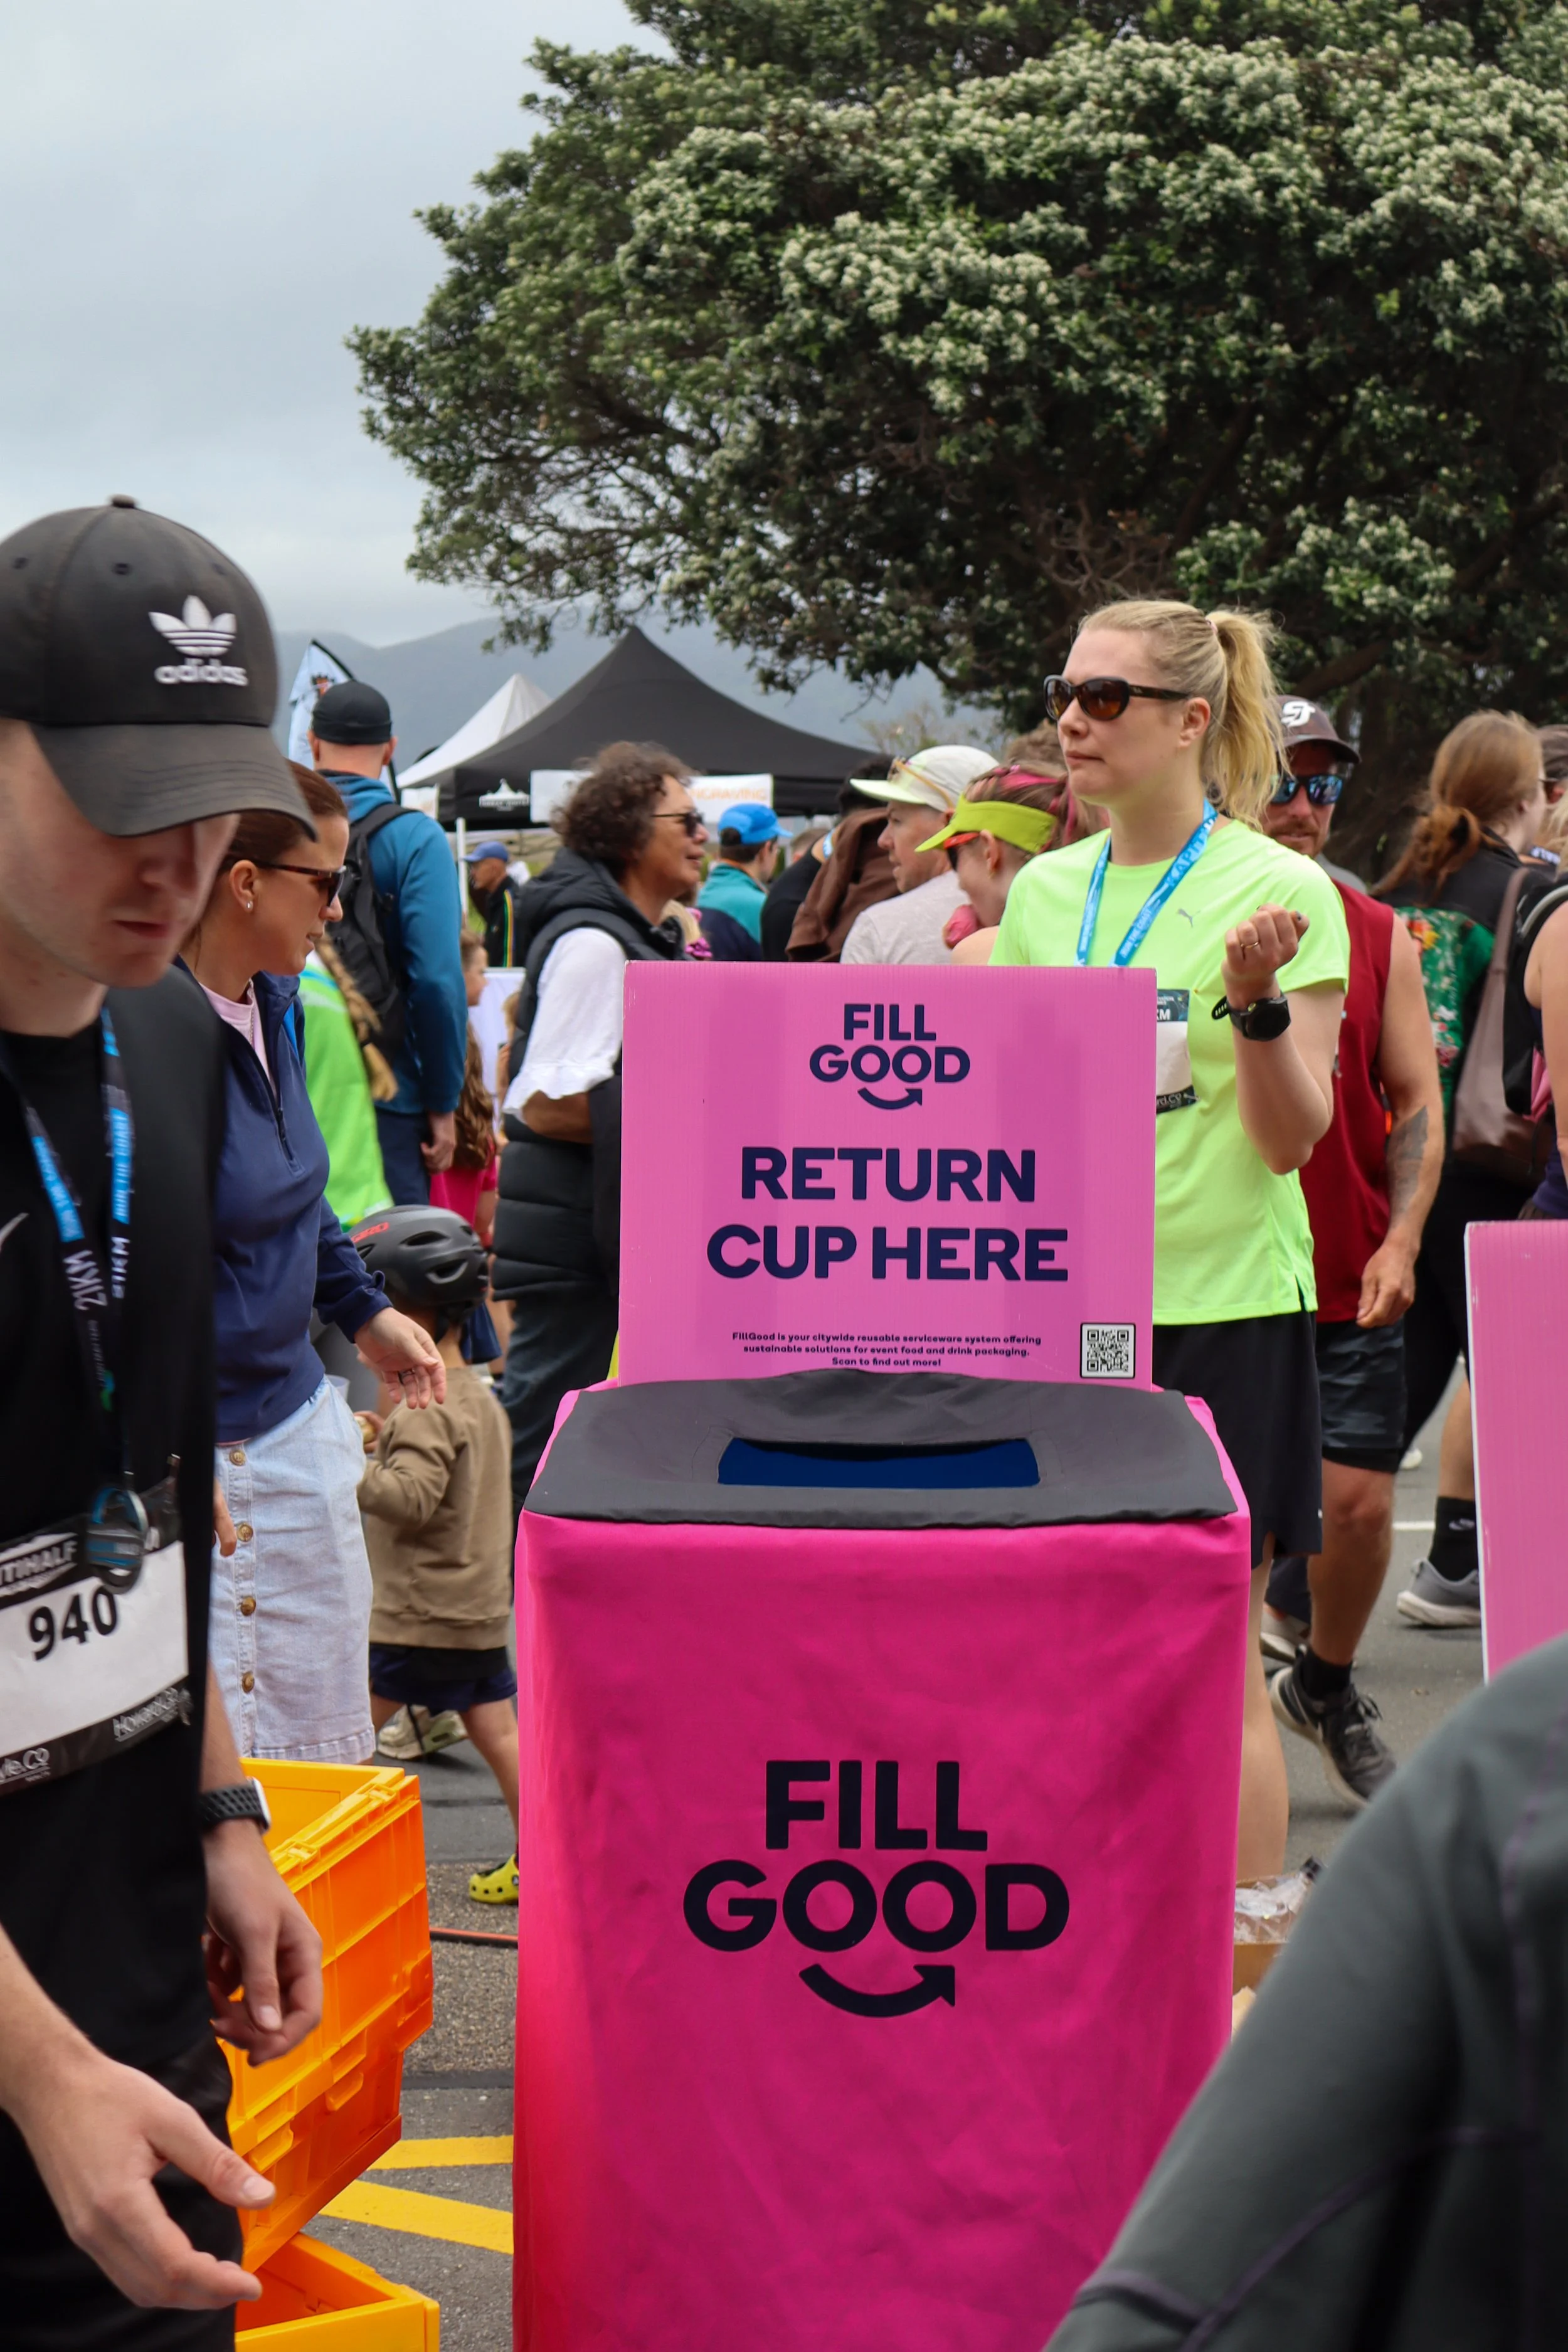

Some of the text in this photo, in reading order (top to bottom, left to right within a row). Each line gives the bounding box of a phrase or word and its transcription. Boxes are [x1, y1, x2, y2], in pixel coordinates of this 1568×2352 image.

[154, 657, 248, 686] adidas
[691, 787, 767, 801] NGRAVING
[844, 1004, 936, 1041] FILL
[810, 1045, 970, 1083] GOOD
[742, 1147, 1035, 1202] RETURN
[707, 1224, 1067, 1281] CUP HERE
[63, 1249, 108, 1311] 21KM
[733, 1332, 775, 1340] FillGood
[813, 1333, 854, 1343] citywide
[965, 1336, 1000, 1345] system
[1004, 1335, 1041, 1345] offering
[901, 1346, 923, 1354] food
[975, 1347, 1029, 1357] packaging.
[29, 1585, 117, 1661] 940
[766, 1761, 987, 1851] FILL
[684, 1860, 1069, 1952] GOOD
